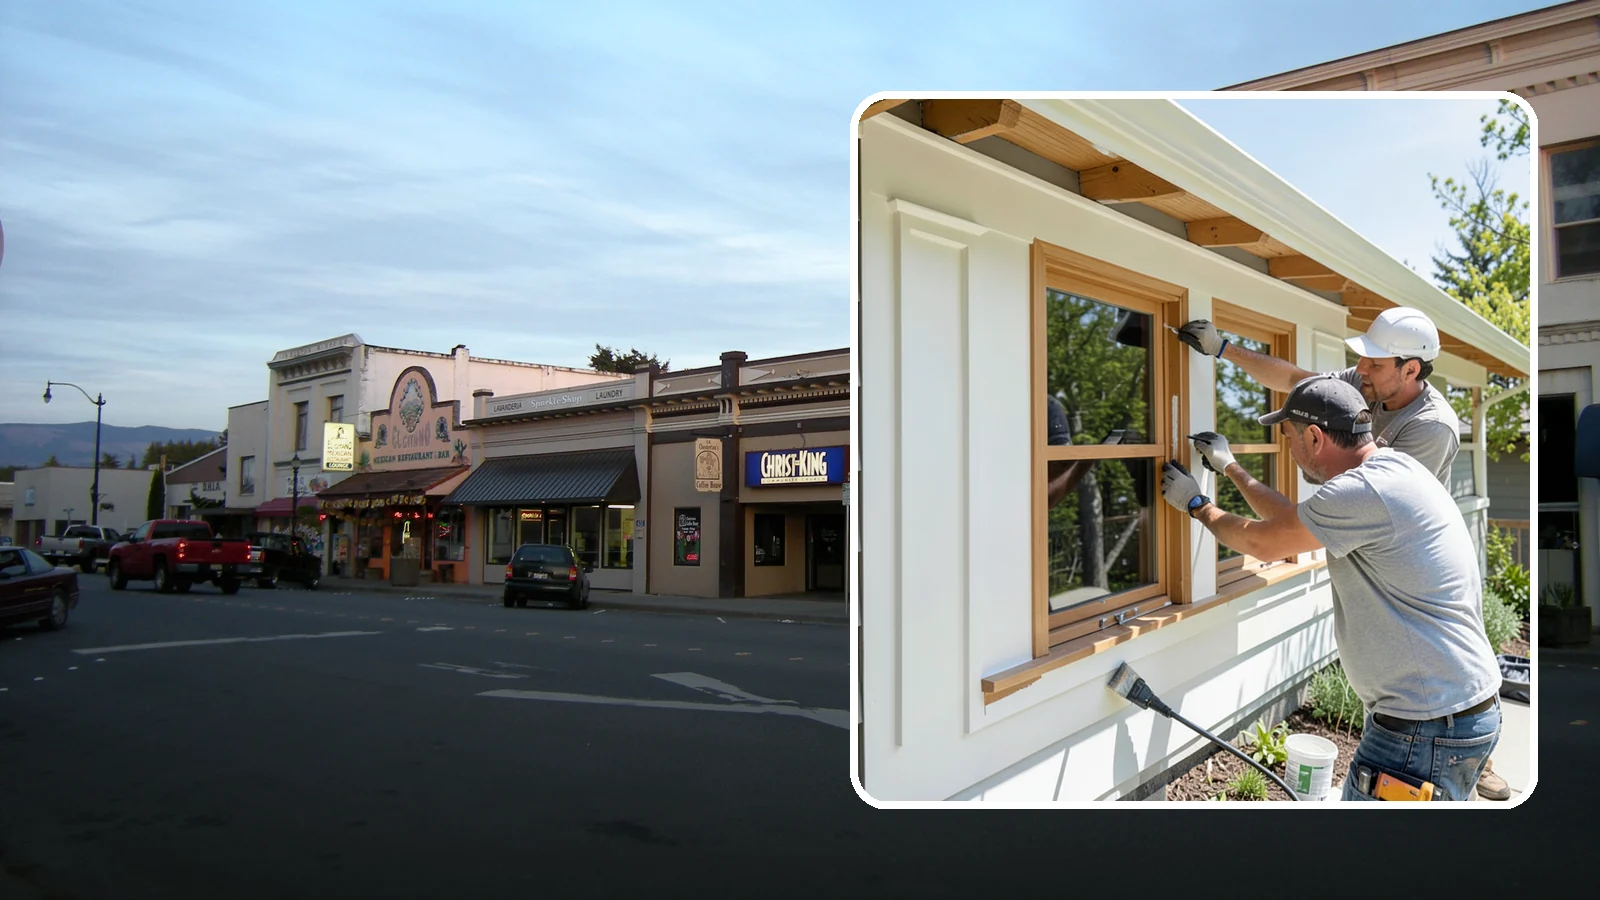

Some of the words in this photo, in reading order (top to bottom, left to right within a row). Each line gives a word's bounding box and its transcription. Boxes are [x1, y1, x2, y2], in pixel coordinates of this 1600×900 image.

[595, 389, 623, 400] LAUNDRY
[494, 402, 522, 412] LAVANDERIA
[531, 399, 560, 408] Sparkle
[562, 395, 582, 404] Shop
[374, 454, 396, 464] MEXICAN
[397, 451, 433, 462] RESTAURANT
[438, 450, 449, 459] BAR
[761, 452, 797, 477] CHRIST
[799, 450, 828, 476] KING
